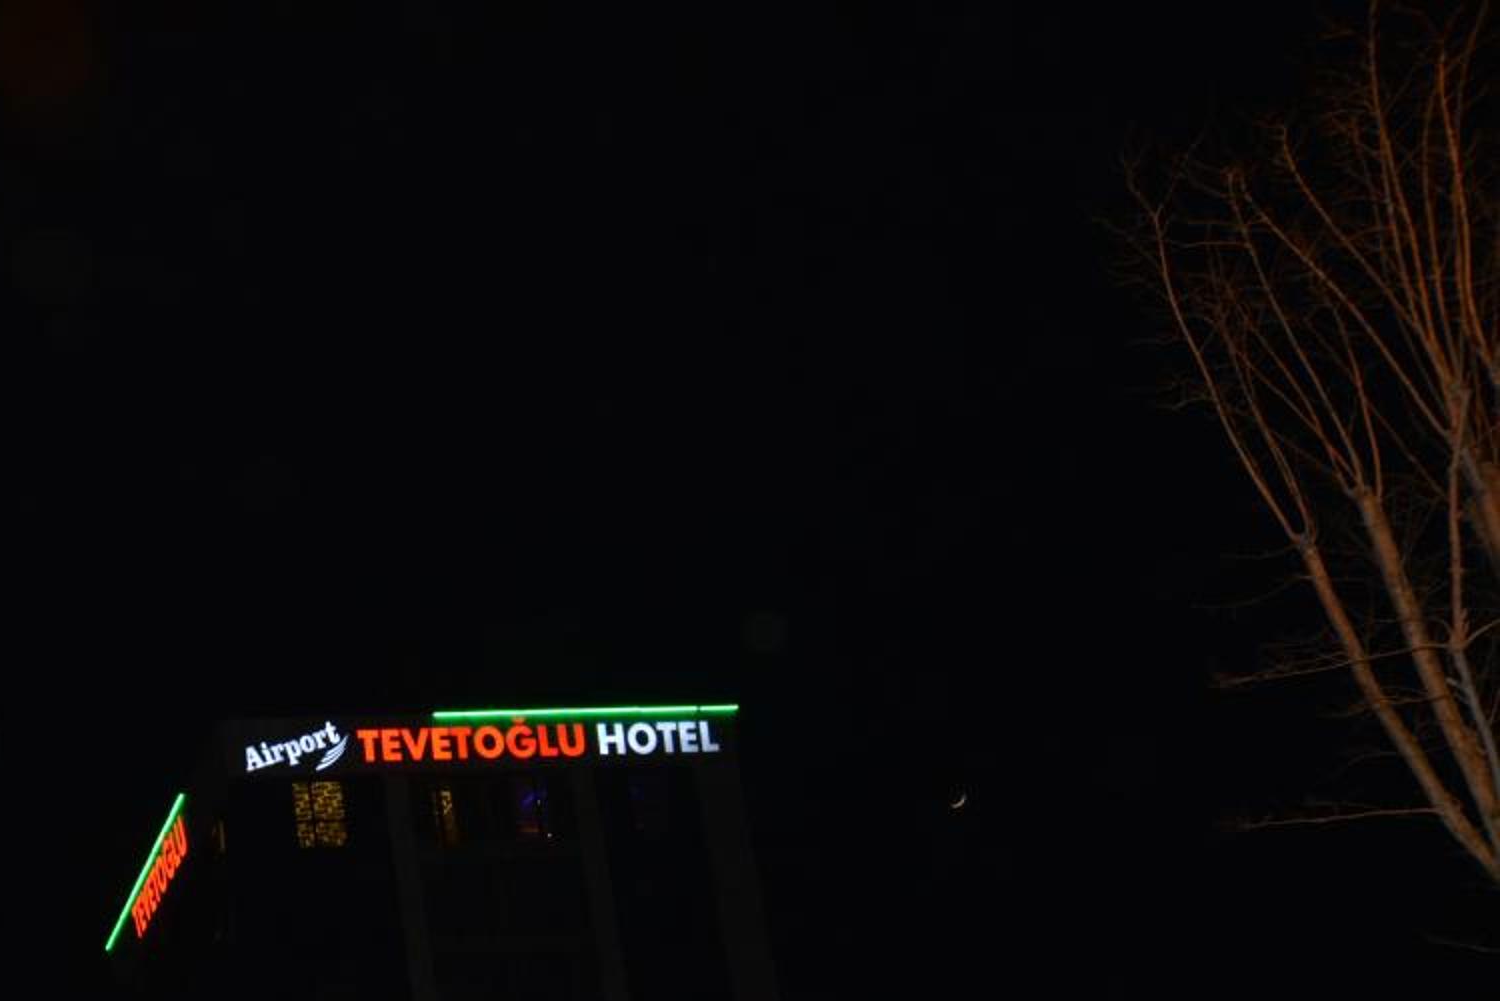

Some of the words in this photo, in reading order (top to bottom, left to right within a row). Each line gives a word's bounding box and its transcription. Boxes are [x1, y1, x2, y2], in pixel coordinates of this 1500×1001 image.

[245, 720, 341, 773] Airport
[356, 714, 585, 763] TEVETOĞLU
[596, 720, 720, 755] HOTEL
[131, 813, 188, 938] TEVETOĞLU
